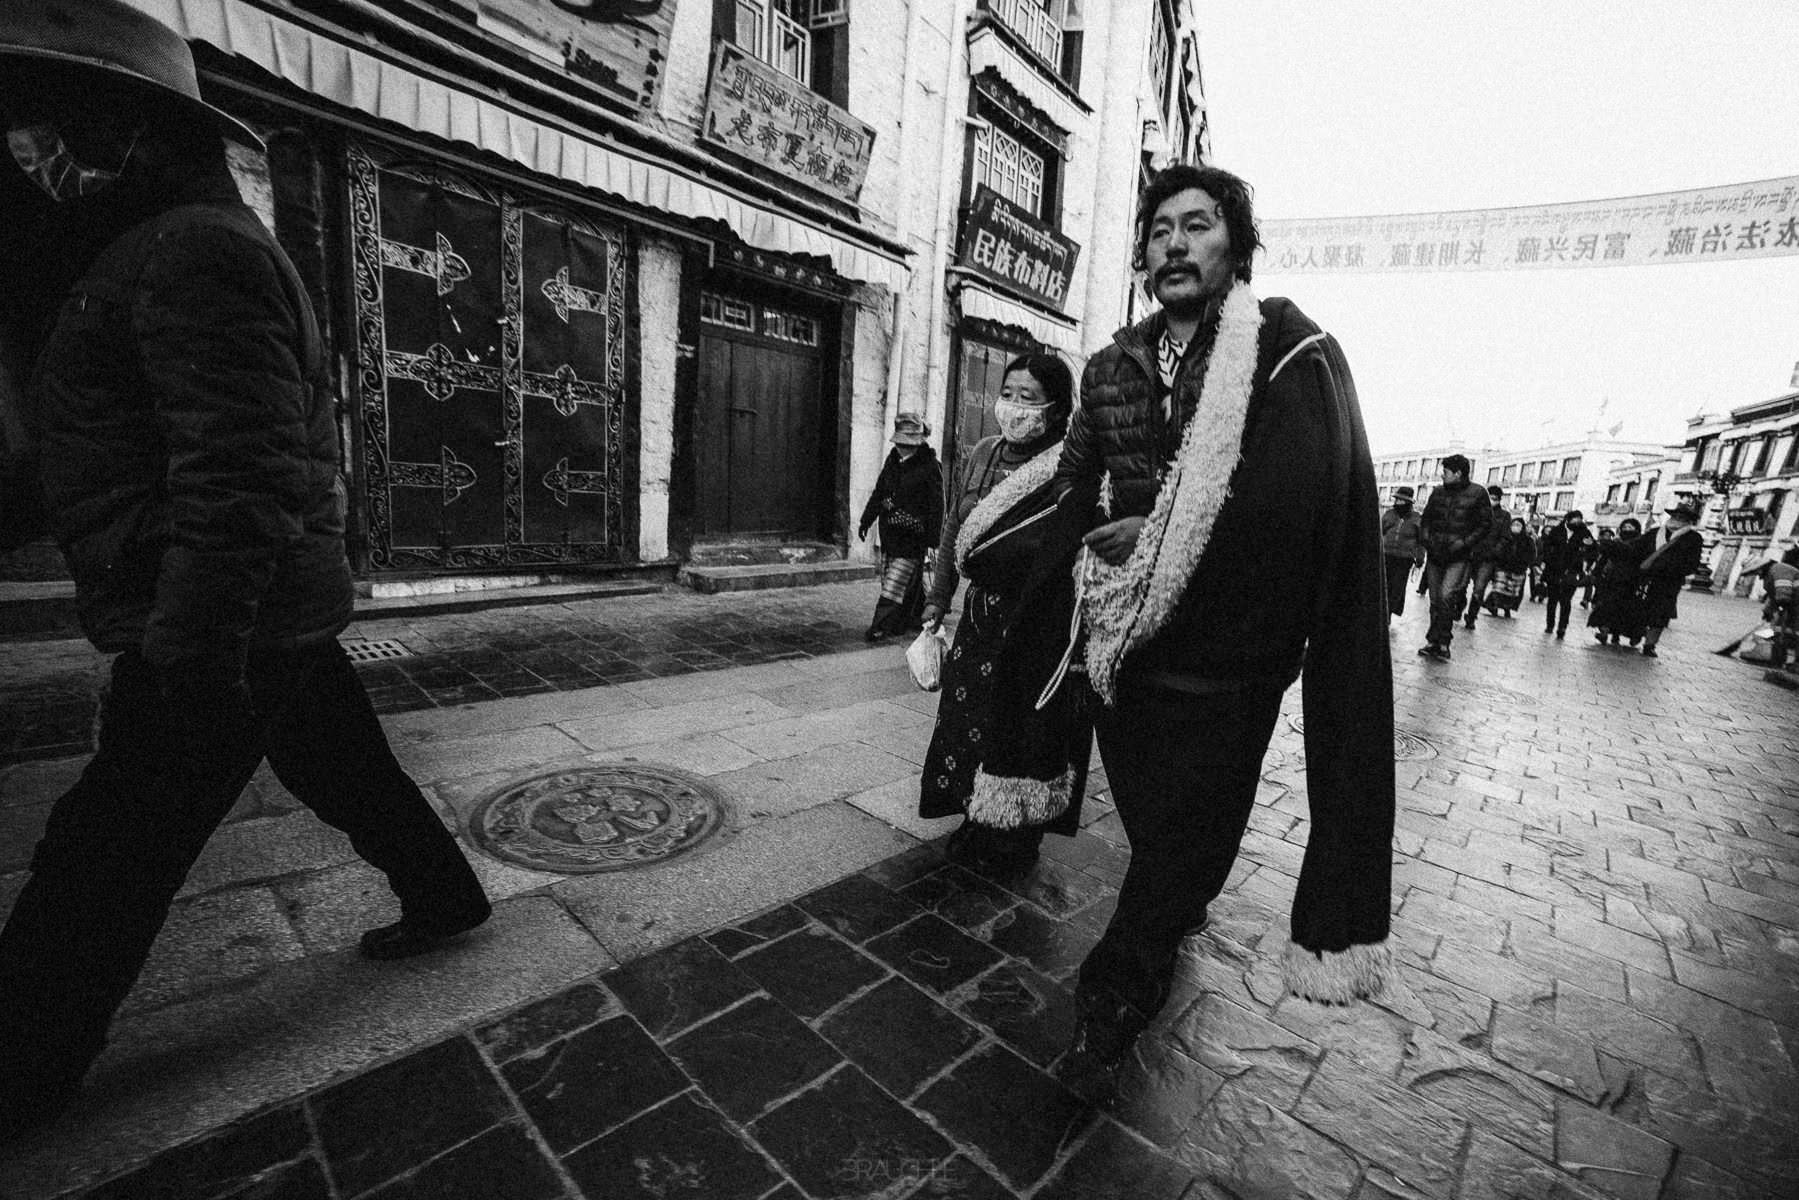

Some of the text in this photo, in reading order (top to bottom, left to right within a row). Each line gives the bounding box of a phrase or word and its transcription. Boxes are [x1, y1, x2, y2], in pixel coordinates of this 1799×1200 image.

[973, 227, 1067, 300] 民族布料店
